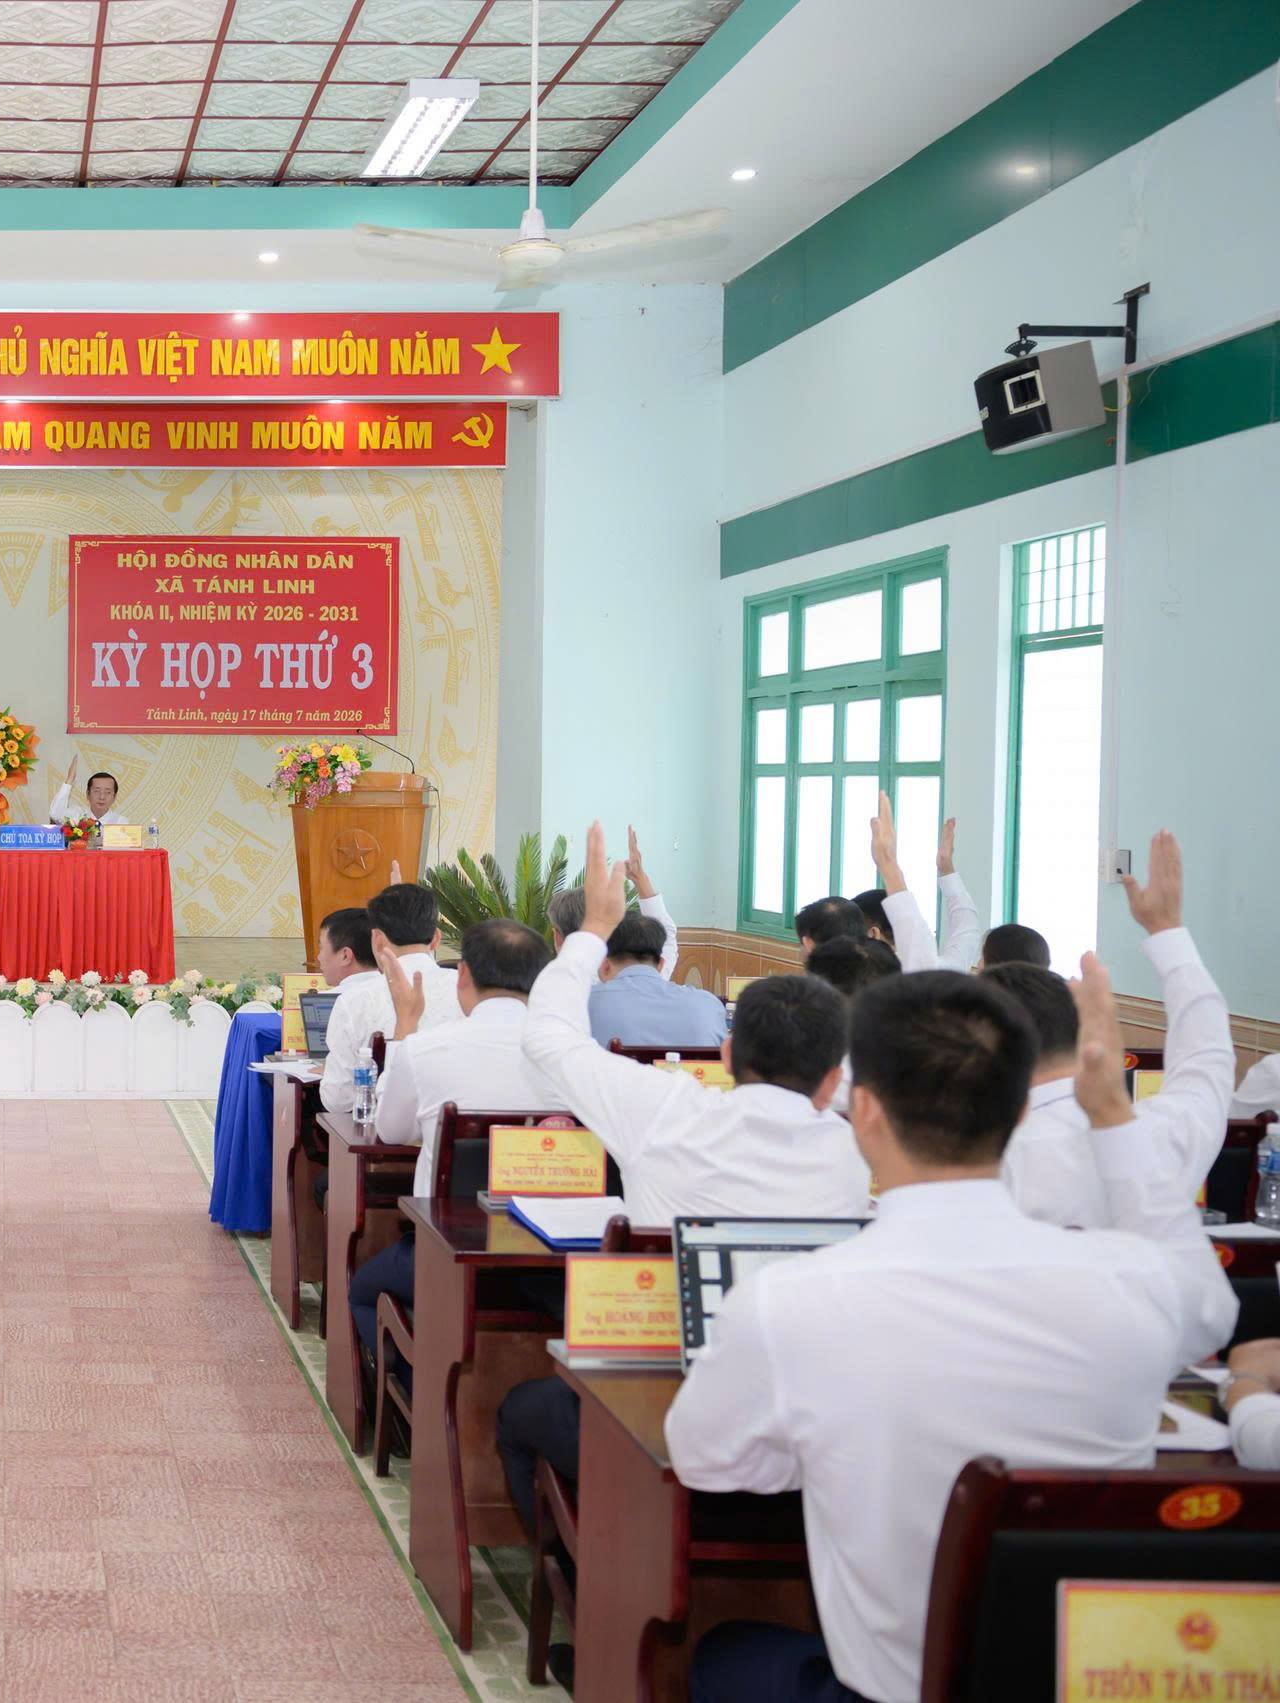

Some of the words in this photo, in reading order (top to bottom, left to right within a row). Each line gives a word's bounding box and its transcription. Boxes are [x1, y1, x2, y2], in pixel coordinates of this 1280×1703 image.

[39, 331, 128, 377] NGHĨA
[137, 331, 199, 384] VIỆT
[211, 338, 280, 376] NAM
[291, 330, 379, 376] MUÔN
[390, 330, 461, 376] NĂM
[44, 421, 151, 453] QUANG
[166, 421, 239, 450] VINH
[251, 415, 345, 450] MUÔN
[358, 415, 434, 450] NĂM
[116, 549, 157, 571] HỘI
[164, 547, 229, 569] ĐỒNG
[235, 551, 299, 569] NHÂN
[306, 551, 354, 569] DÂN
[154, 575, 185, 594] XÃ
[192, 574, 254, 594] TÁNH
[262, 579, 316, 594] LINH
[110, 601, 154, 621] KHÓA
[159, 606, 174, 623] II,
[179, 601, 232, 624] NHIỆM
[236, 602, 258, 621] KỲ
[264, 606, 304, 621] 2026
[319, 606, 359, 621] 2031
[91, 628, 148, 688] KỲ
[160, 642, 243, 700] HỌP
[254, 629, 339, 690] THỨ
[351, 642, 374, 690] 3
[146, 708, 176, 721] Tánh
[177, 708, 208, 723] Linh,
[210, 710, 239, 726] ngày
[242, 709, 257, 722] 17
[259, 709, 294, 726] tháng
[296, 710, 304, 722] 7
[306, 710, 331, 722] năm
[333, 709, 363, 722] 2026
[0, 830, 16, 844] CHỦ
[18, 832, 33, 846] TỌA
[47, 832, 62, 846] HỌP
[1181, 1493, 1220, 1520] 35
[1083, 1659, 1154, 1698] THÔN
[1163, 1661, 1212, 1699] TÂN
